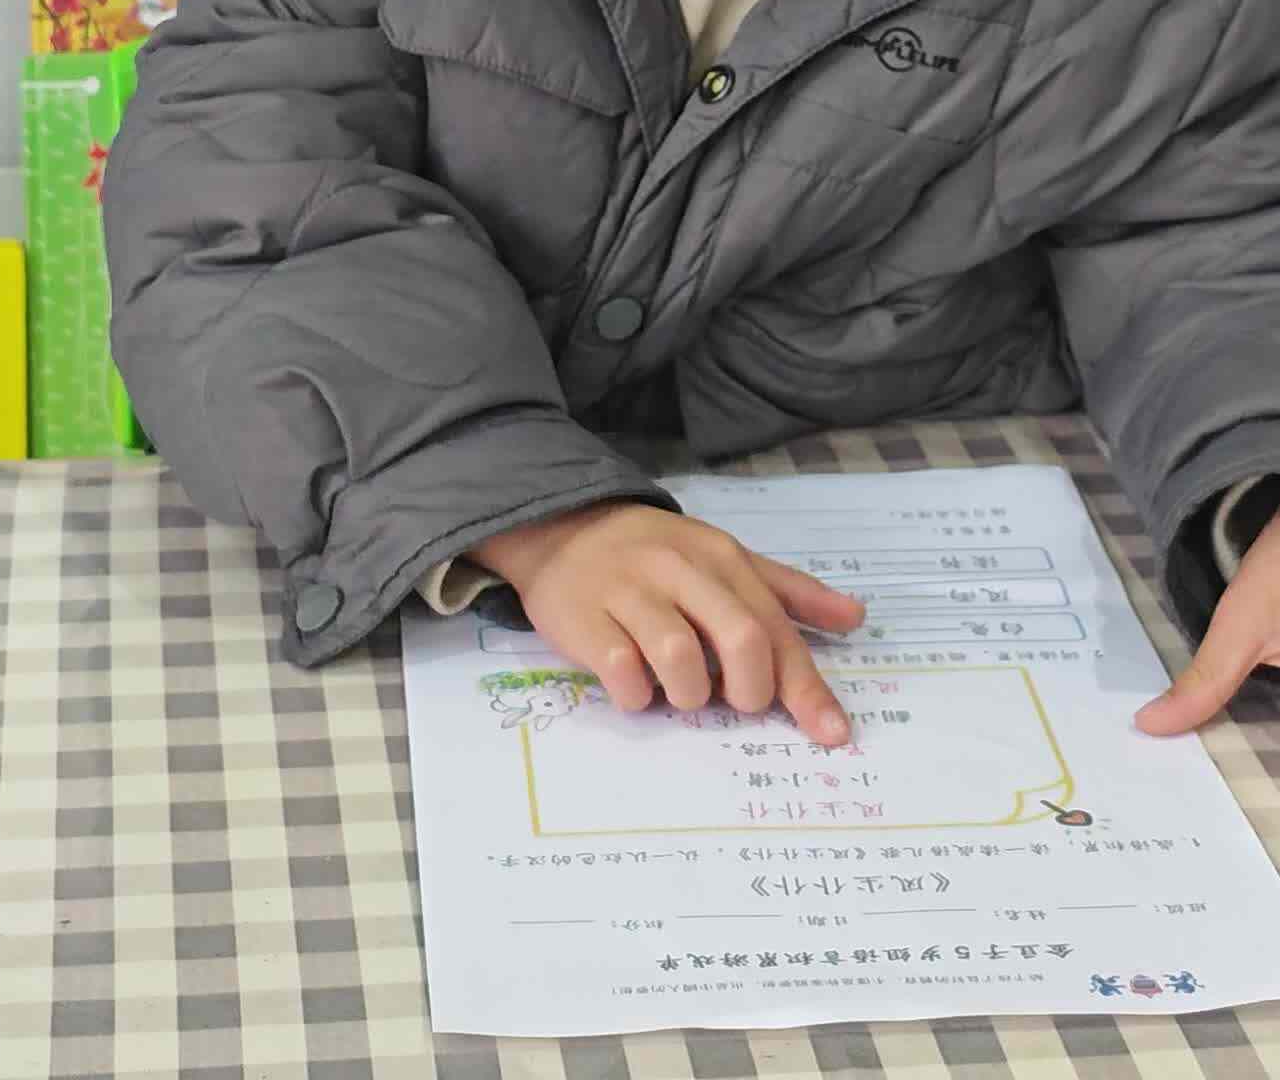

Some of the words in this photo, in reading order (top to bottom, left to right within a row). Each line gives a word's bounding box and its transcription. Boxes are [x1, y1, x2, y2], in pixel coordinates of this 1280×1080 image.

[737, 799, 884, 821] 风尘仆仆
[749, 872, 952, 897] 《风尘仆仆》
